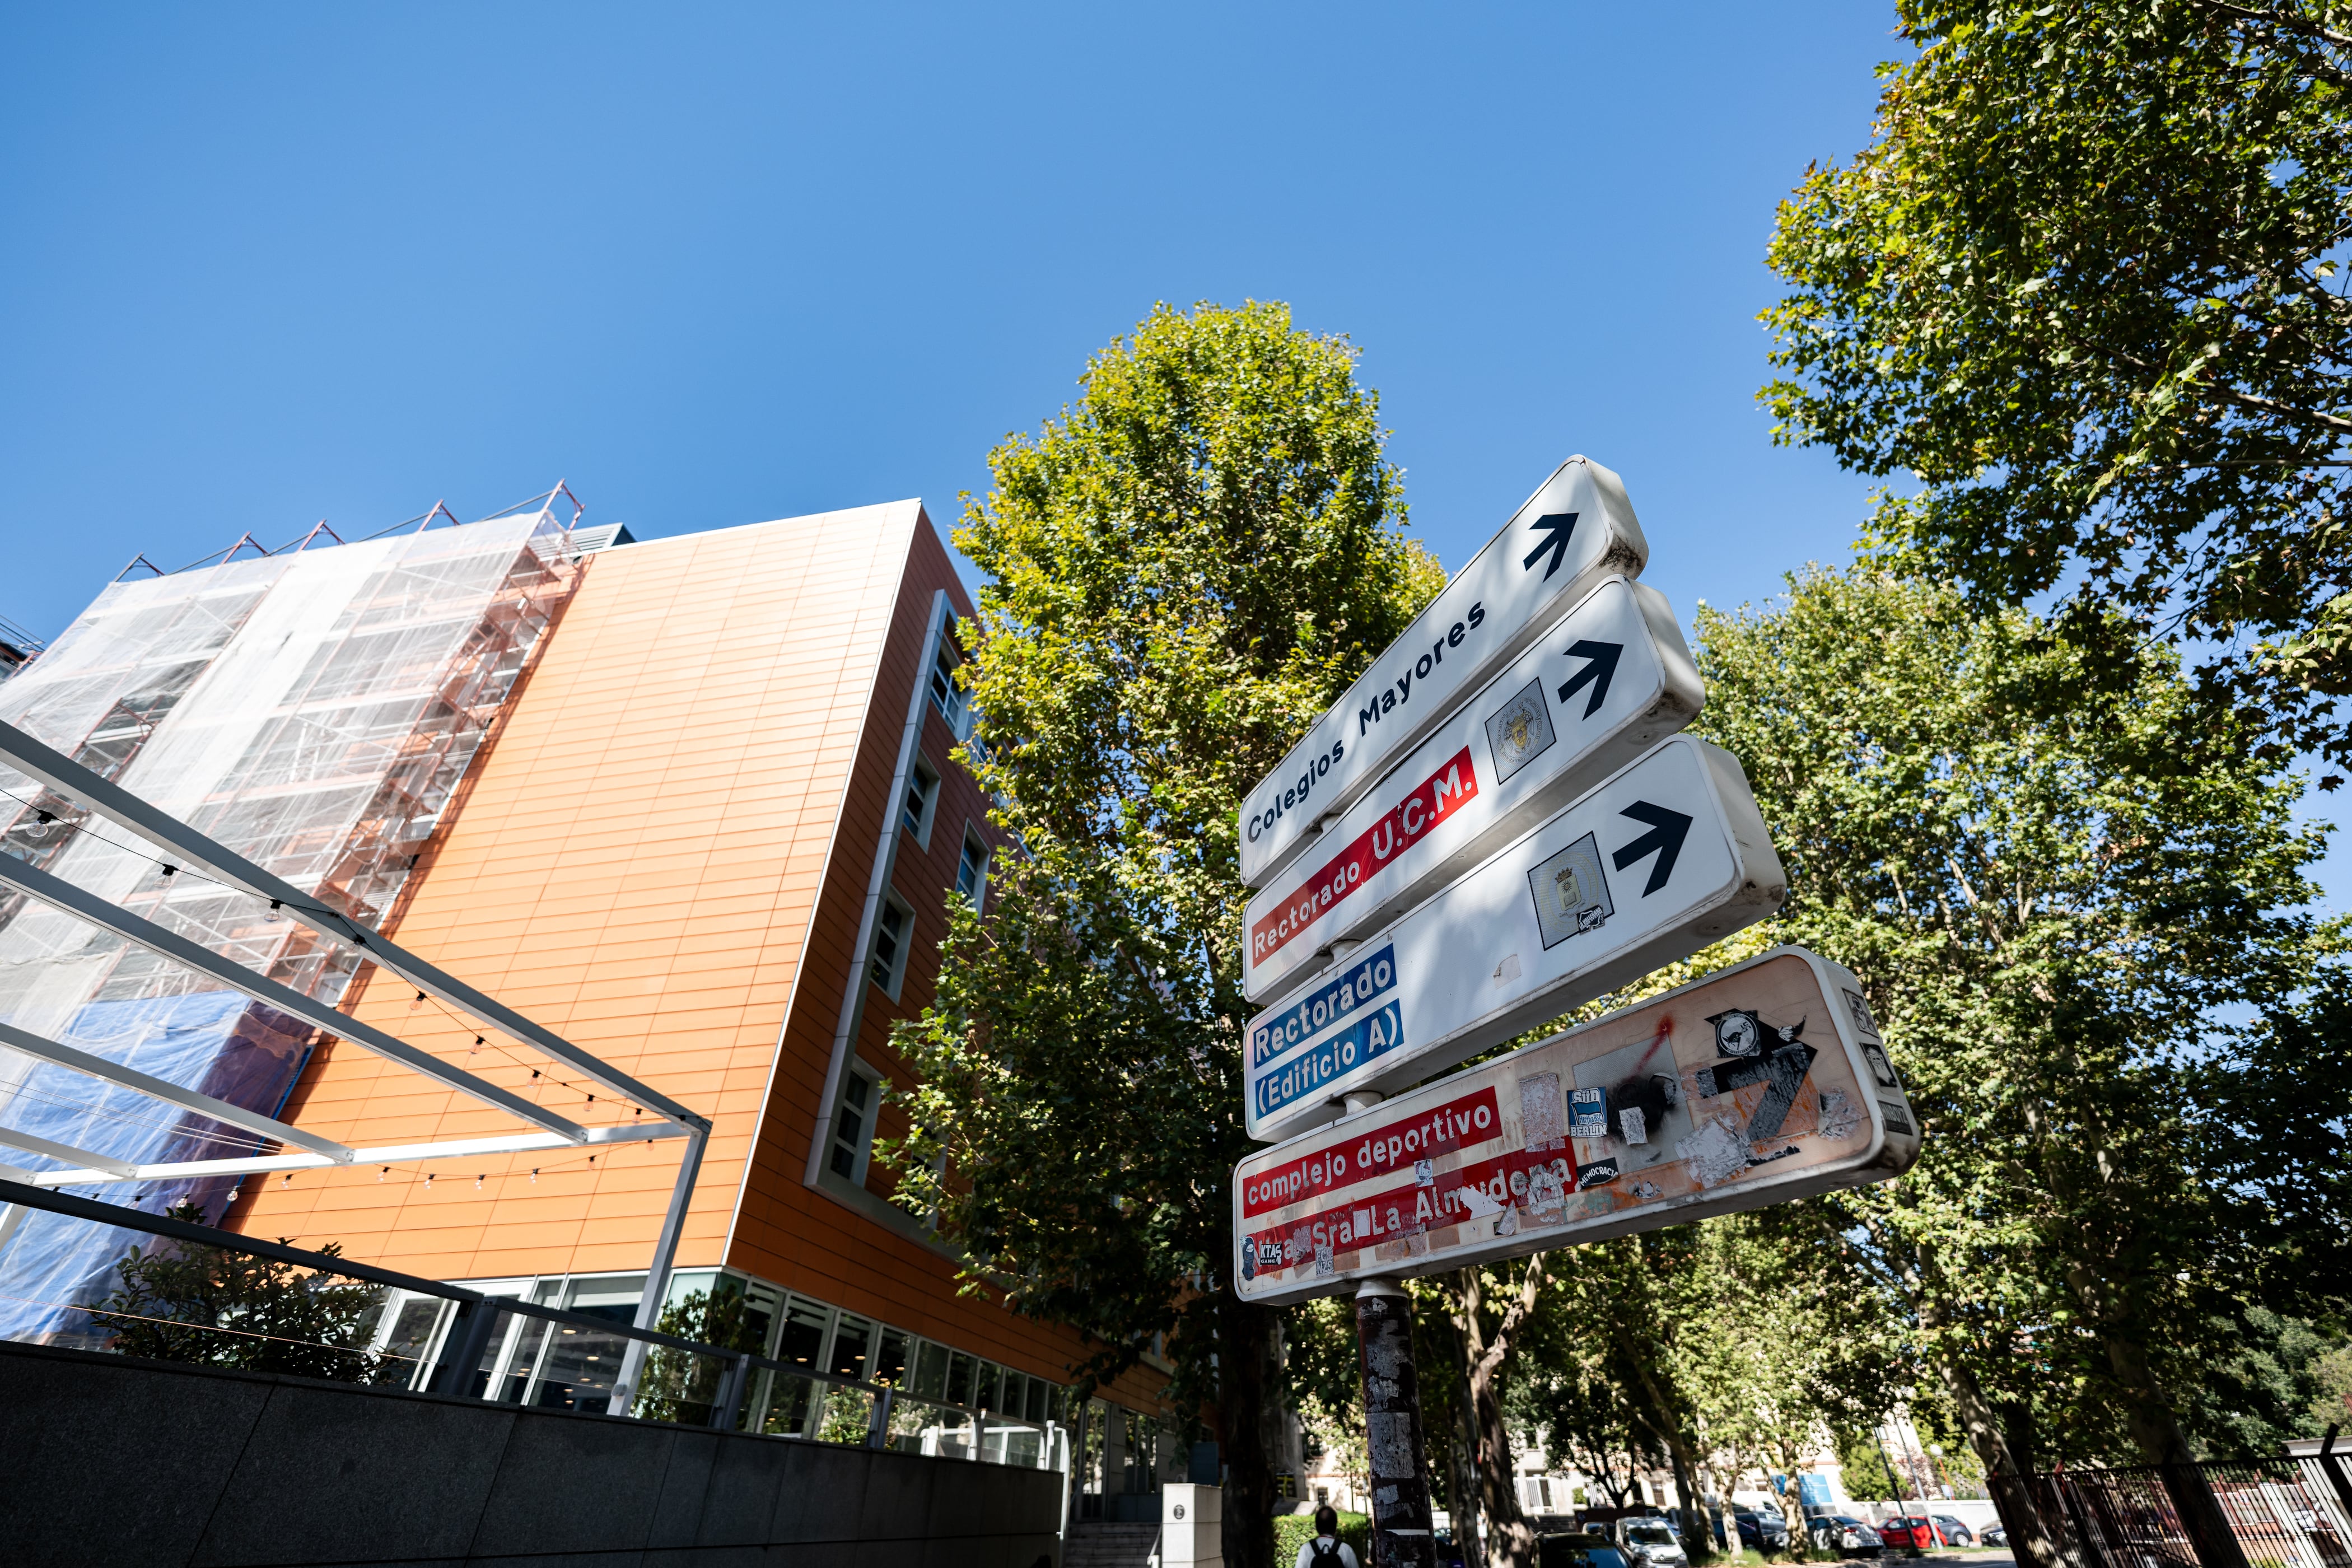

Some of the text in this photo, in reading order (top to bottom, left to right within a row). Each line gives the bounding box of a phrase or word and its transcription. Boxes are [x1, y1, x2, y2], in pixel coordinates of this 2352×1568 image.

[1248, 601, 1485, 843] Colegios Mayores
[1255, 763, 1472, 958] Rectorado U.C.M.
[1256, 960, 1391, 1063] Rectorado
[1258, 1007, 1397, 1114] (Edificio A)
[1248, 1105, 1491, 1205] complejo deportivo
[1570, 1124, 1607, 1137] BERLIN
[1261, 1244, 1282, 1262] KTAS
[1371, 1205, 1401, 1235] La
